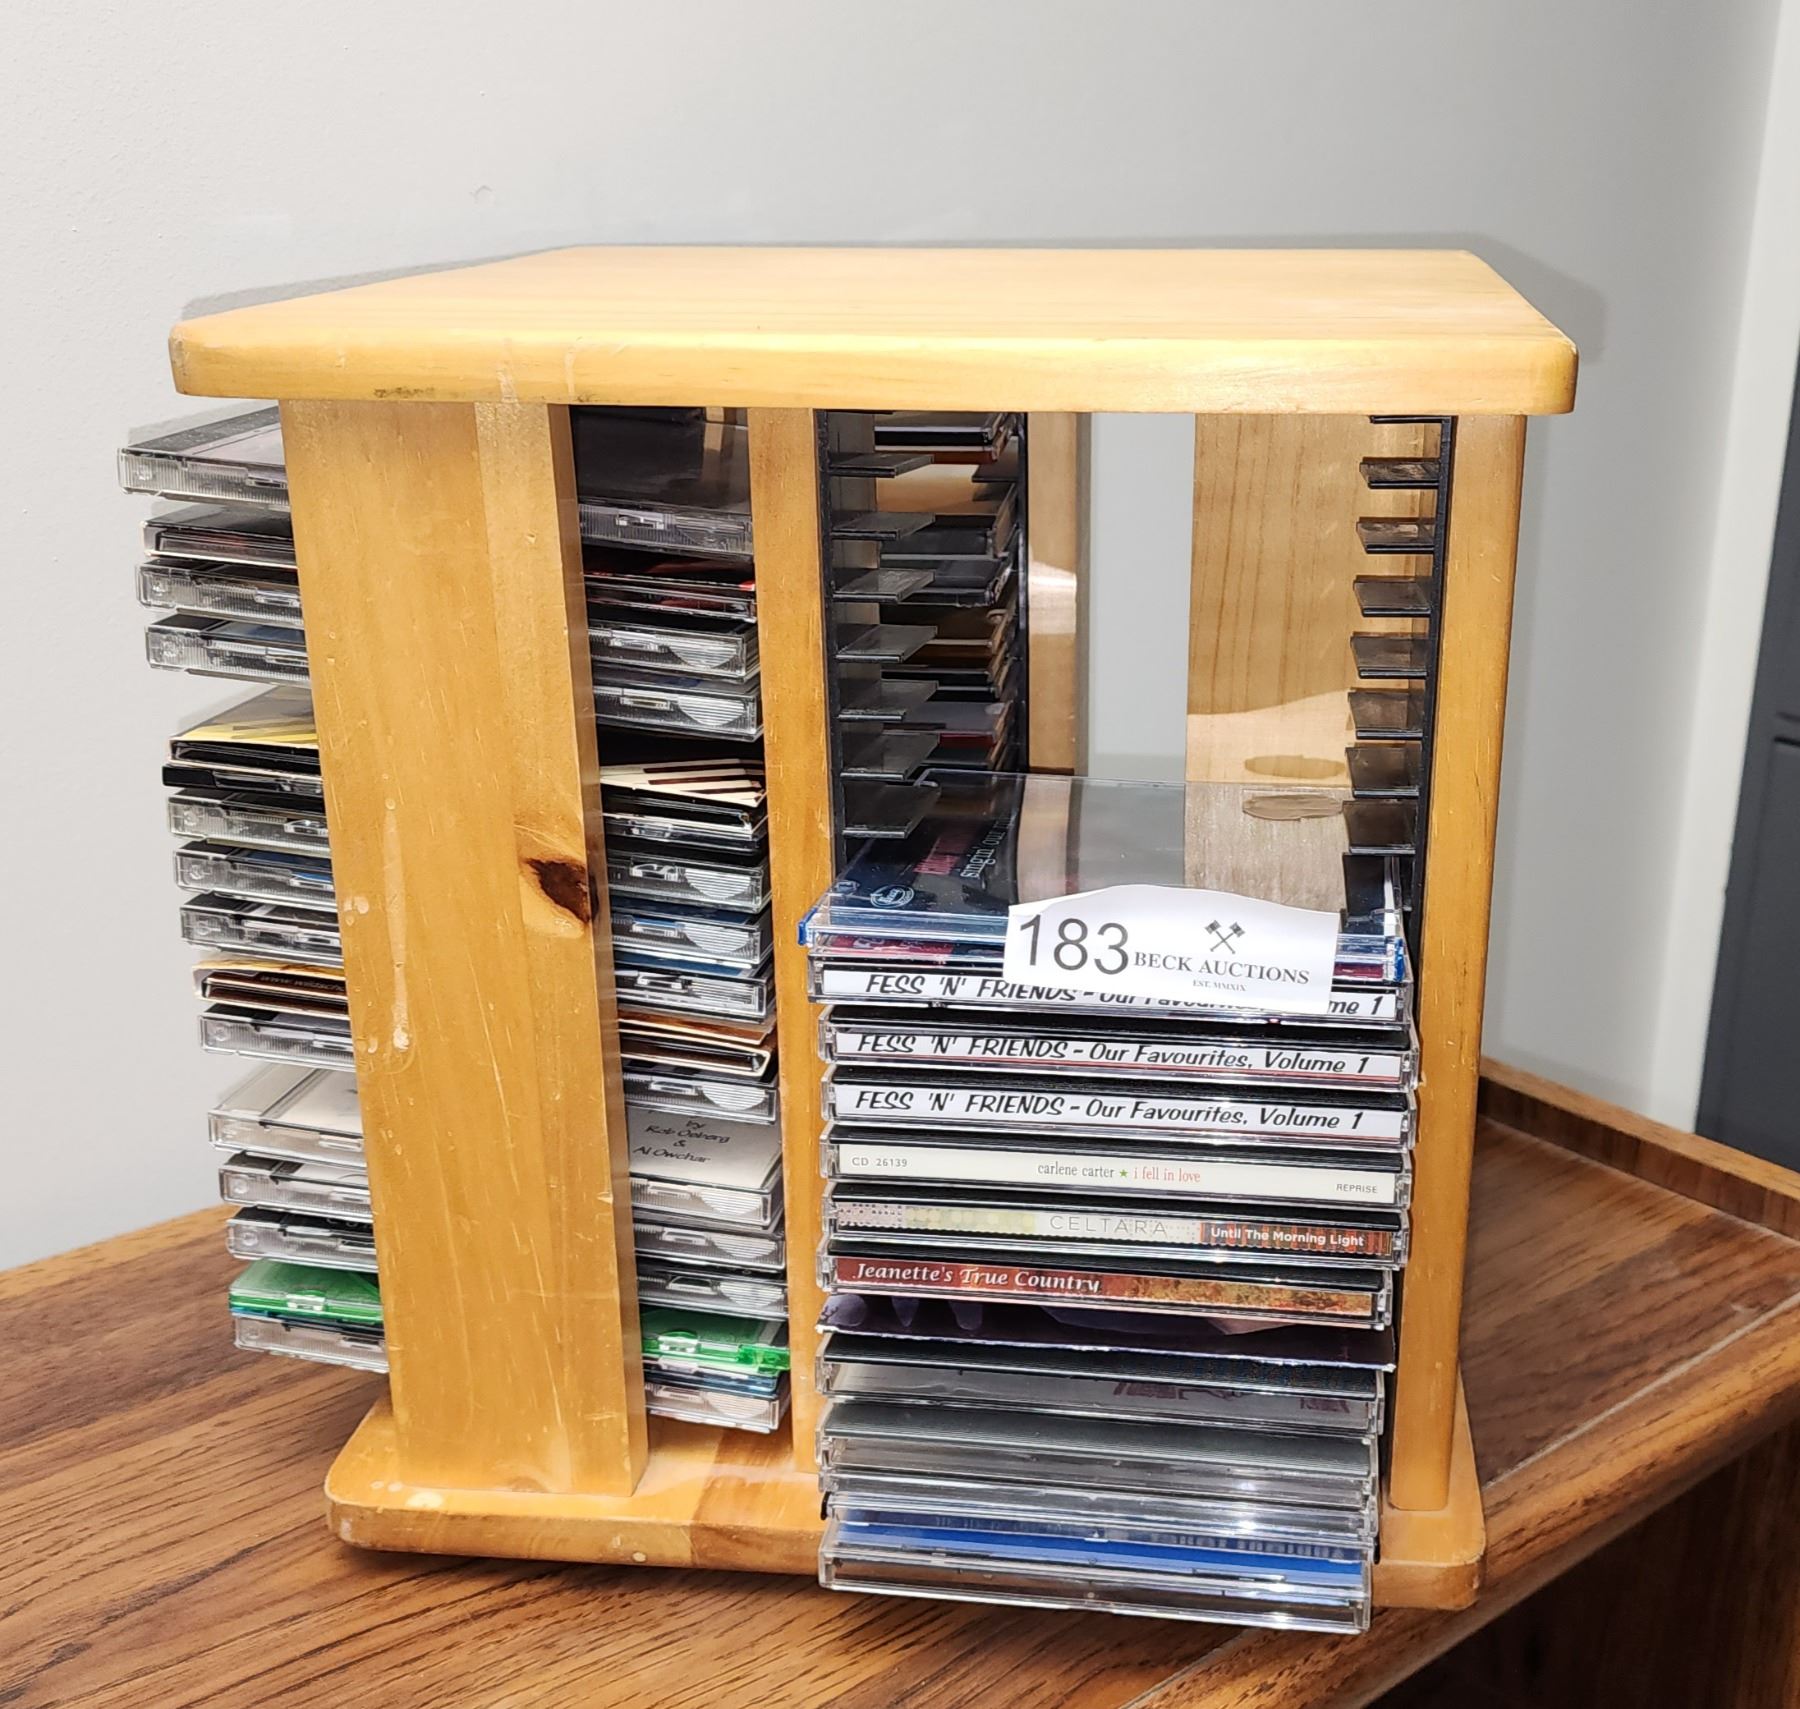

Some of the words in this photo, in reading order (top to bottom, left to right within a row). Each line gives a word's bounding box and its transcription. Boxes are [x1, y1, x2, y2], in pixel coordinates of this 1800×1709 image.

[1020, 914, 1129, 975] 183
[1134, 951, 1192, 973] BECK
[1199, 959, 1310, 985] AUCTIONS
[866, 974, 926, 995] FESS
[939, 977, 967, 997] 'N'
[1370, 997, 1383, 1016] 1
[858, 1033, 916, 1053] FESS
[931, 1035, 957, 1054] 'N'
[968, 1038, 1068, 1059] FRIENDS
[1090, 1043, 1130, 1062] Our
[1134, 1045, 1253, 1069] Favourites,
[1264, 1050, 1346, 1073] Volume
[1356, 1057, 1371, 1074] 1
[856, 1090, 914, 1111] FESS
[929, 1092, 955, 1112] 'N'
[965, 1094, 1065, 1116] FRIENDS
[1086, 1099, 1126, 1119] Our
[1130, 1101, 1248, 1125] Favourites,
[1259, 1107, 1340, 1130] Volume
[1351, 1112, 1364, 1130] 1
[852, 1157, 869, 1167] CD
[876, 1158, 908, 1168] 26139
[1037, 1161, 1078, 1176] carlene
[1081, 1166, 1115, 1178] carter
[1134, 1167, 1138, 1179] i
[1142, 1166, 1159, 1181] fell
[1163, 1168, 1175, 1181] in
[1178, 1168, 1201, 1183] love
[1336, 1183, 1378, 1194] REPRISE
[1049, 1215, 1169, 1238] CELTARA
[1211, 1226, 1241, 1239] Until
[1244, 1229, 1268, 1241] The
[1273, 1232, 1326, 1247] Morning
[1330, 1234, 1364, 1248] Light
[856, 1263, 953, 1282] Jeanette's
[959, 1267, 1008, 1285] True
[1015, 1271, 1100, 1293] Country
